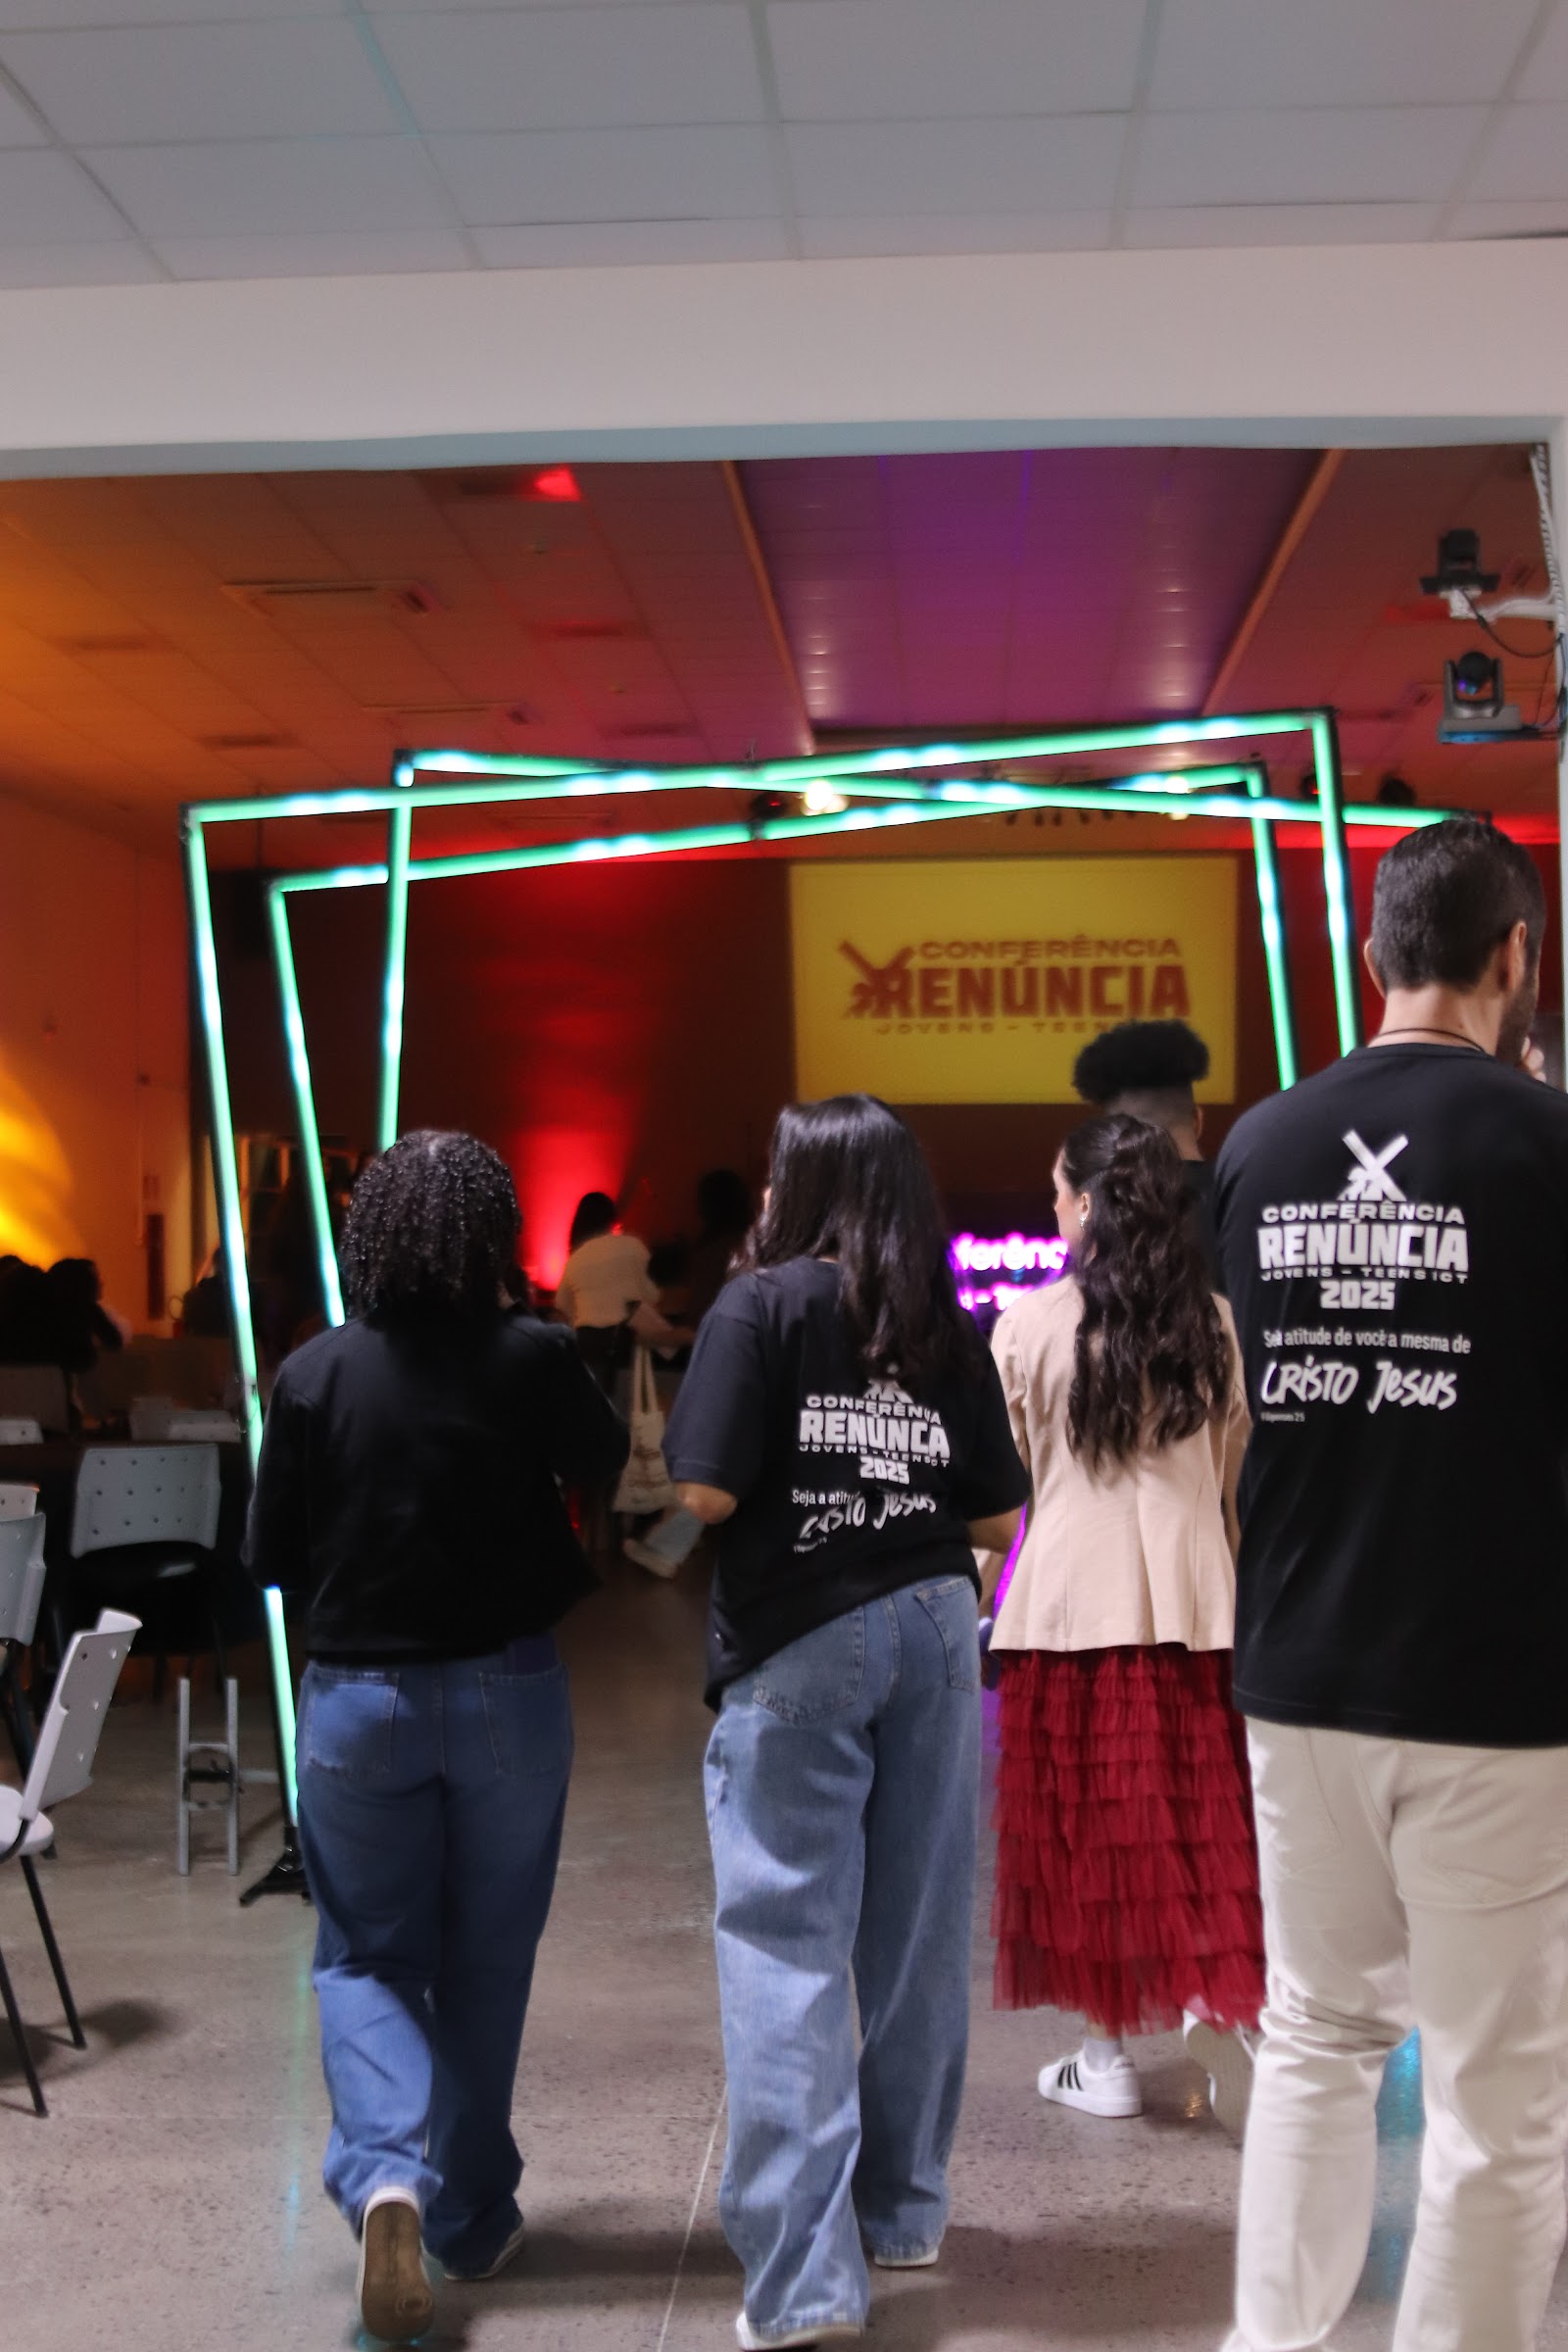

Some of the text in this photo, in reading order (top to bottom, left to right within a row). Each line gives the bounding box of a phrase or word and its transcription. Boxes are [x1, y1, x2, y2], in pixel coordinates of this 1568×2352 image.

[917, 934, 1182, 959] CONFERÊNCIA
[872, 957, 1192, 1019] RENÚNCIA
[1261, 1201, 1465, 1224] CONFERÊNCIA
[1257, 1218, 1469, 1272] RENÚNCIA
[1261, 1267, 1333, 1281] JOVENS
[1361, 1267, 1427, 1281] TEENS
[1320, 1280, 1396, 1310] 2025
[1284, 1326, 1332, 1346] atitude
[1334, 1327, 1352, 1347] de
[1388, 1333, 1398, 1348] a
[1400, 1333, 1449, 1352] mesma
[1451, 1334, 1471, 1353] de
[806, 1396, 941, 1426] CONFERÊNA
[799, 1409, 950, 1458] RENÚNCA
[799, 1445, 867, 1455] JOVENS
[883, 1451, 930, 1463] TEENS
[859, 1455, 909, 1485] 2025
[792, 1489, 816, 1507] Seja
[818, 1493, 826, 1504] a
